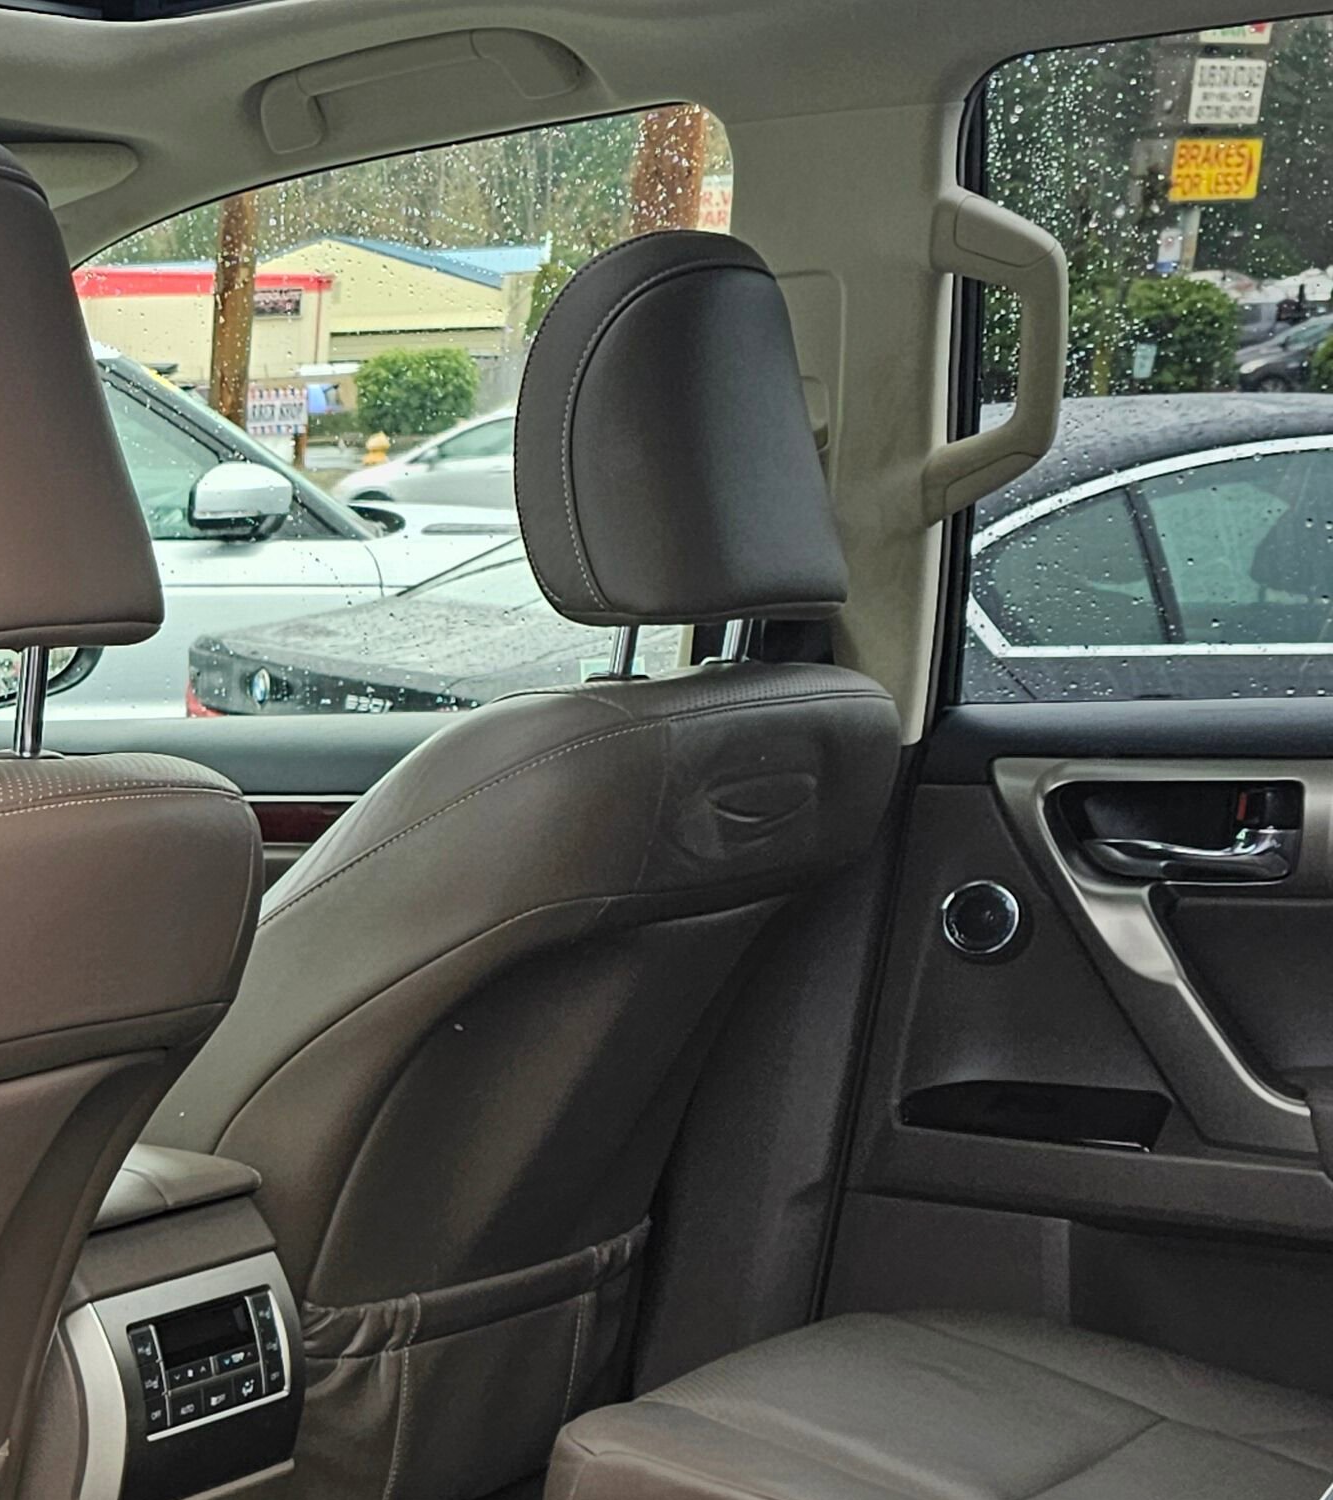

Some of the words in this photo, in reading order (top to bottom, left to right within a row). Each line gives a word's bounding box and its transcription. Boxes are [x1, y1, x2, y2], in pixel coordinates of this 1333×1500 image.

[1177, 144, 1246, 168] BRAKES
[1171, 173, 1201, 195] FOR
[1207, 172, 1242, 194] LESS
